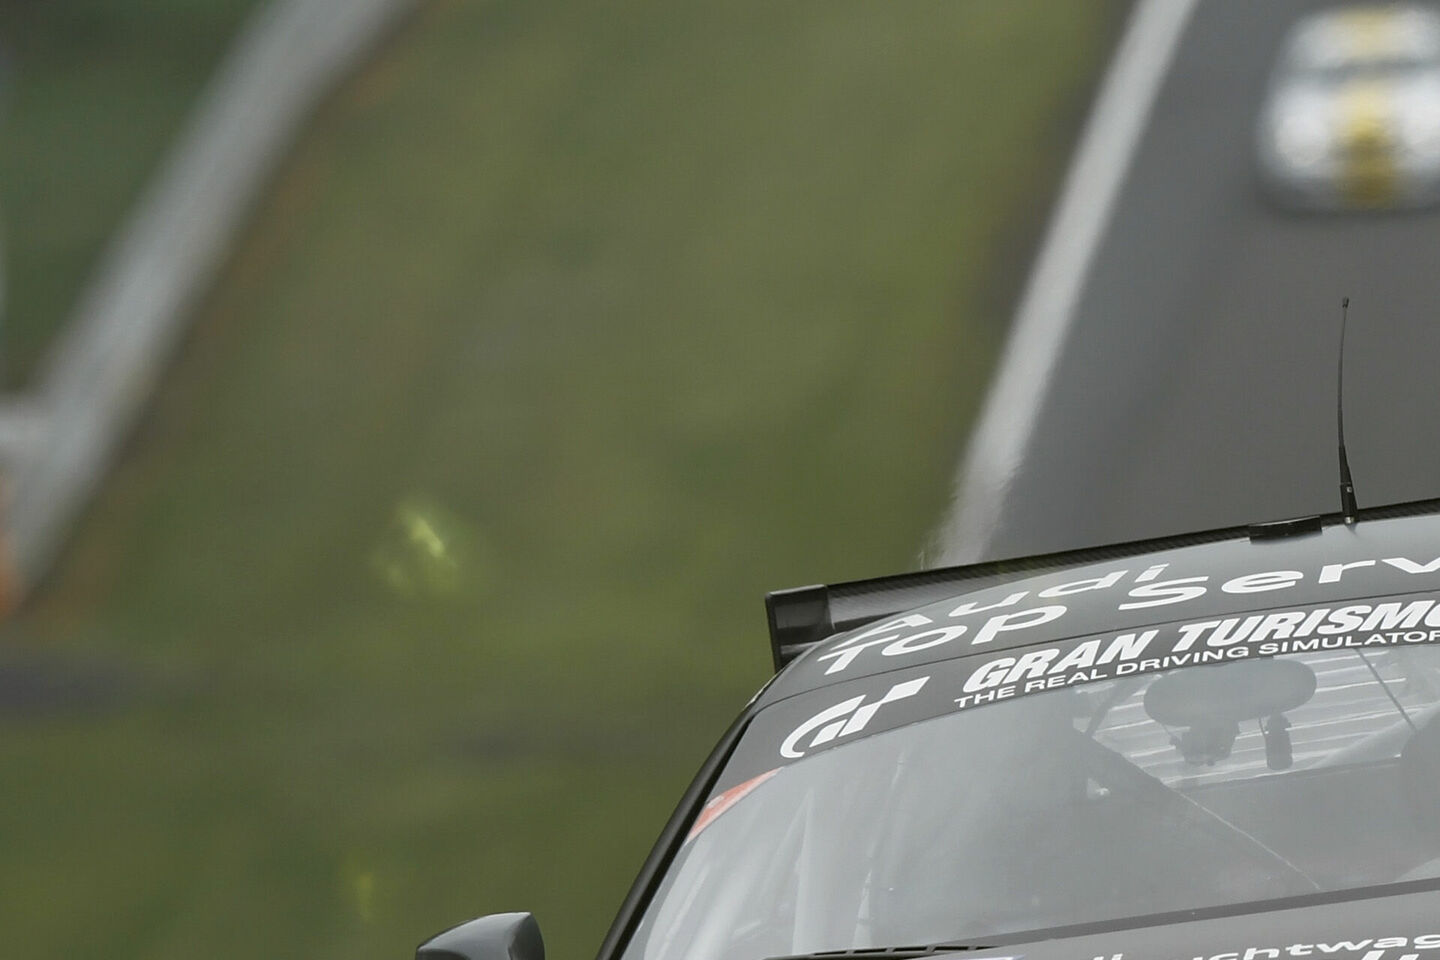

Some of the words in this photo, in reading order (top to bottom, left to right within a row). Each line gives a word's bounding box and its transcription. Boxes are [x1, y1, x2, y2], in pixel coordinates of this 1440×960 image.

[817, 605, 1067, 675] Top
[828, 564, 1170, 648] Audi
[954, 685, 1016, 709] THE
[1024, 668, 1108, 694] REAL
[1116, 643, 1250, 677] DRIVING
[962, 630, 1159, 693] GRAN
